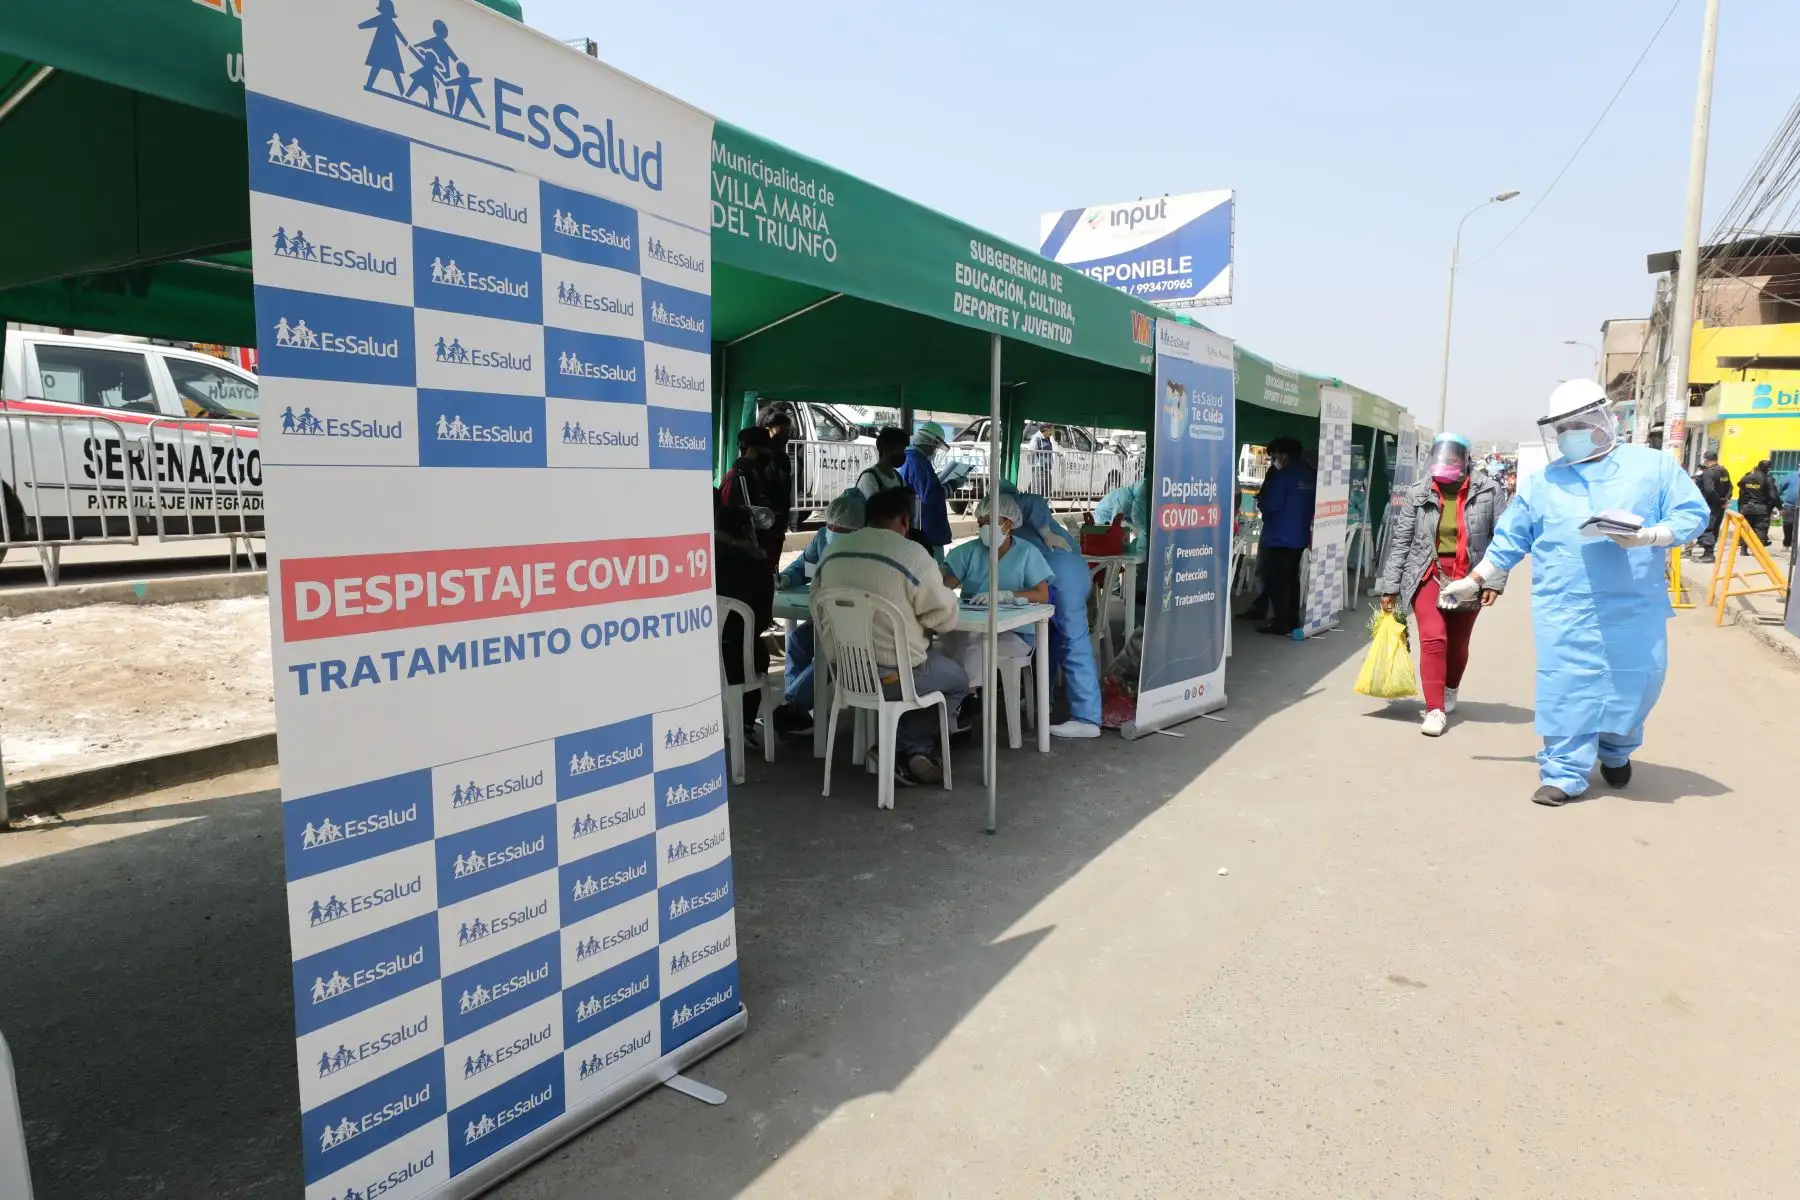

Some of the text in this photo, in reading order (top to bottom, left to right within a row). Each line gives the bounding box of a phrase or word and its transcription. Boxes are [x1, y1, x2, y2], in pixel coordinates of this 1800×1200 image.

[493, 77, 663, 191] EsSalud
[315, 155, 393, 192] EsSalud
[712, 140, 834, 207] Municipalidad de
[467, 194, 528, 224] EsSalud
[712, 170, 829, 234] VILLA MARÍA
[1111, 199, 1167, 230] input
[582, 224, 631, 250] EsSalud
[711, 200, 837, 263] DEL TRIUNFO
[320, 246, 397, 276] EsSalud
[667, 249, 704, 273] EsSalud
[970, 240, 1062, 292] SUBGERENCIA DE
[468, 272, 528, 298] EsSalud
[955, 262, 1075, 326] EDUCACIÓN, CULTURA,
[1137, 279, 1192, 294] 993470965
[584, 292, 634, 316] EsSalud
[954, 291, 1072, 344] DEPORTE Y JUVENTUD
[669, 312, 705, 333] EsSalud
[321, 333, 398, 359] EsSalud
[471, 349, 531, 372] EsSalud
[585, 363, 636, 383] EsSalud
[671, 374, 705, 392] EsSalud
[1193, 391, 1222, 407] EsSalud
[326, 419, 402, 439] EsSalud
[1192, 407, 1223, 423] Te Cuida
[473, 425, 533, 443] EsSalud
[588, 430, 639, 447] EsSalud
[674, 435, 705, 451] EsSalud
[84, 438, 262, 486] SERENAZGO
[1162, 477, 1217, 503] Despistaje
[1162, 510, 1197, 527] COVID
[1208, 508, 1218, 524] 19
[1177, 545, 1213, 558] Prevención
[295, 562, 556, 621] DESPISTAJE
[566, 554, 670, 591] COVID
[686, 549, 708, 579] 19
[1176, 570, 1208, 583] Detección
[1175, 592, 1215, 607] Tratamiento
[289, 605, 713, 696] TRATAMIENTO OPORTUNO
[689, 721, 719, 743] EsSalud
[597, 743, 643, 768] EsSalud
[486, 770, 544, 800] EsSalud
[691, 774, 722, 800] EsSalud
[344, 804, 417, 838] EsSalud
[600, 803, 646, 830] EsSalud
[487, 836, 545, 869] EsSalud
[690, 829, 725, 855] EsSalud
[600, 861, 647, 891] EsSalud
[350, 875, 422, 914] EsSalud
[691, 882, 729, 910] EsSalud
[491, 899, 548, 934] EsSalud
[602, 919, 649, 949] EsSalud
[691, 936, 731, 964] EsSalud
[353, 947, 424, 988] EsSalud
[492, 962, 549, 1000] EsSalud
[603, 975, 649, 1010] EsSalud
[693, 986, 732, 1018] EsSalud
[359, 1016, 428, 1060] EsSalud
[496, 1024, 552, 1063] EsSalud
[605, 1031, 651, 1066] EsSalud
[361, 1085, 430, 1131] EsSalud
[497, 1085, 552, 1126] EsSalud
[366, 1151, 434, 1200] EsSalud
